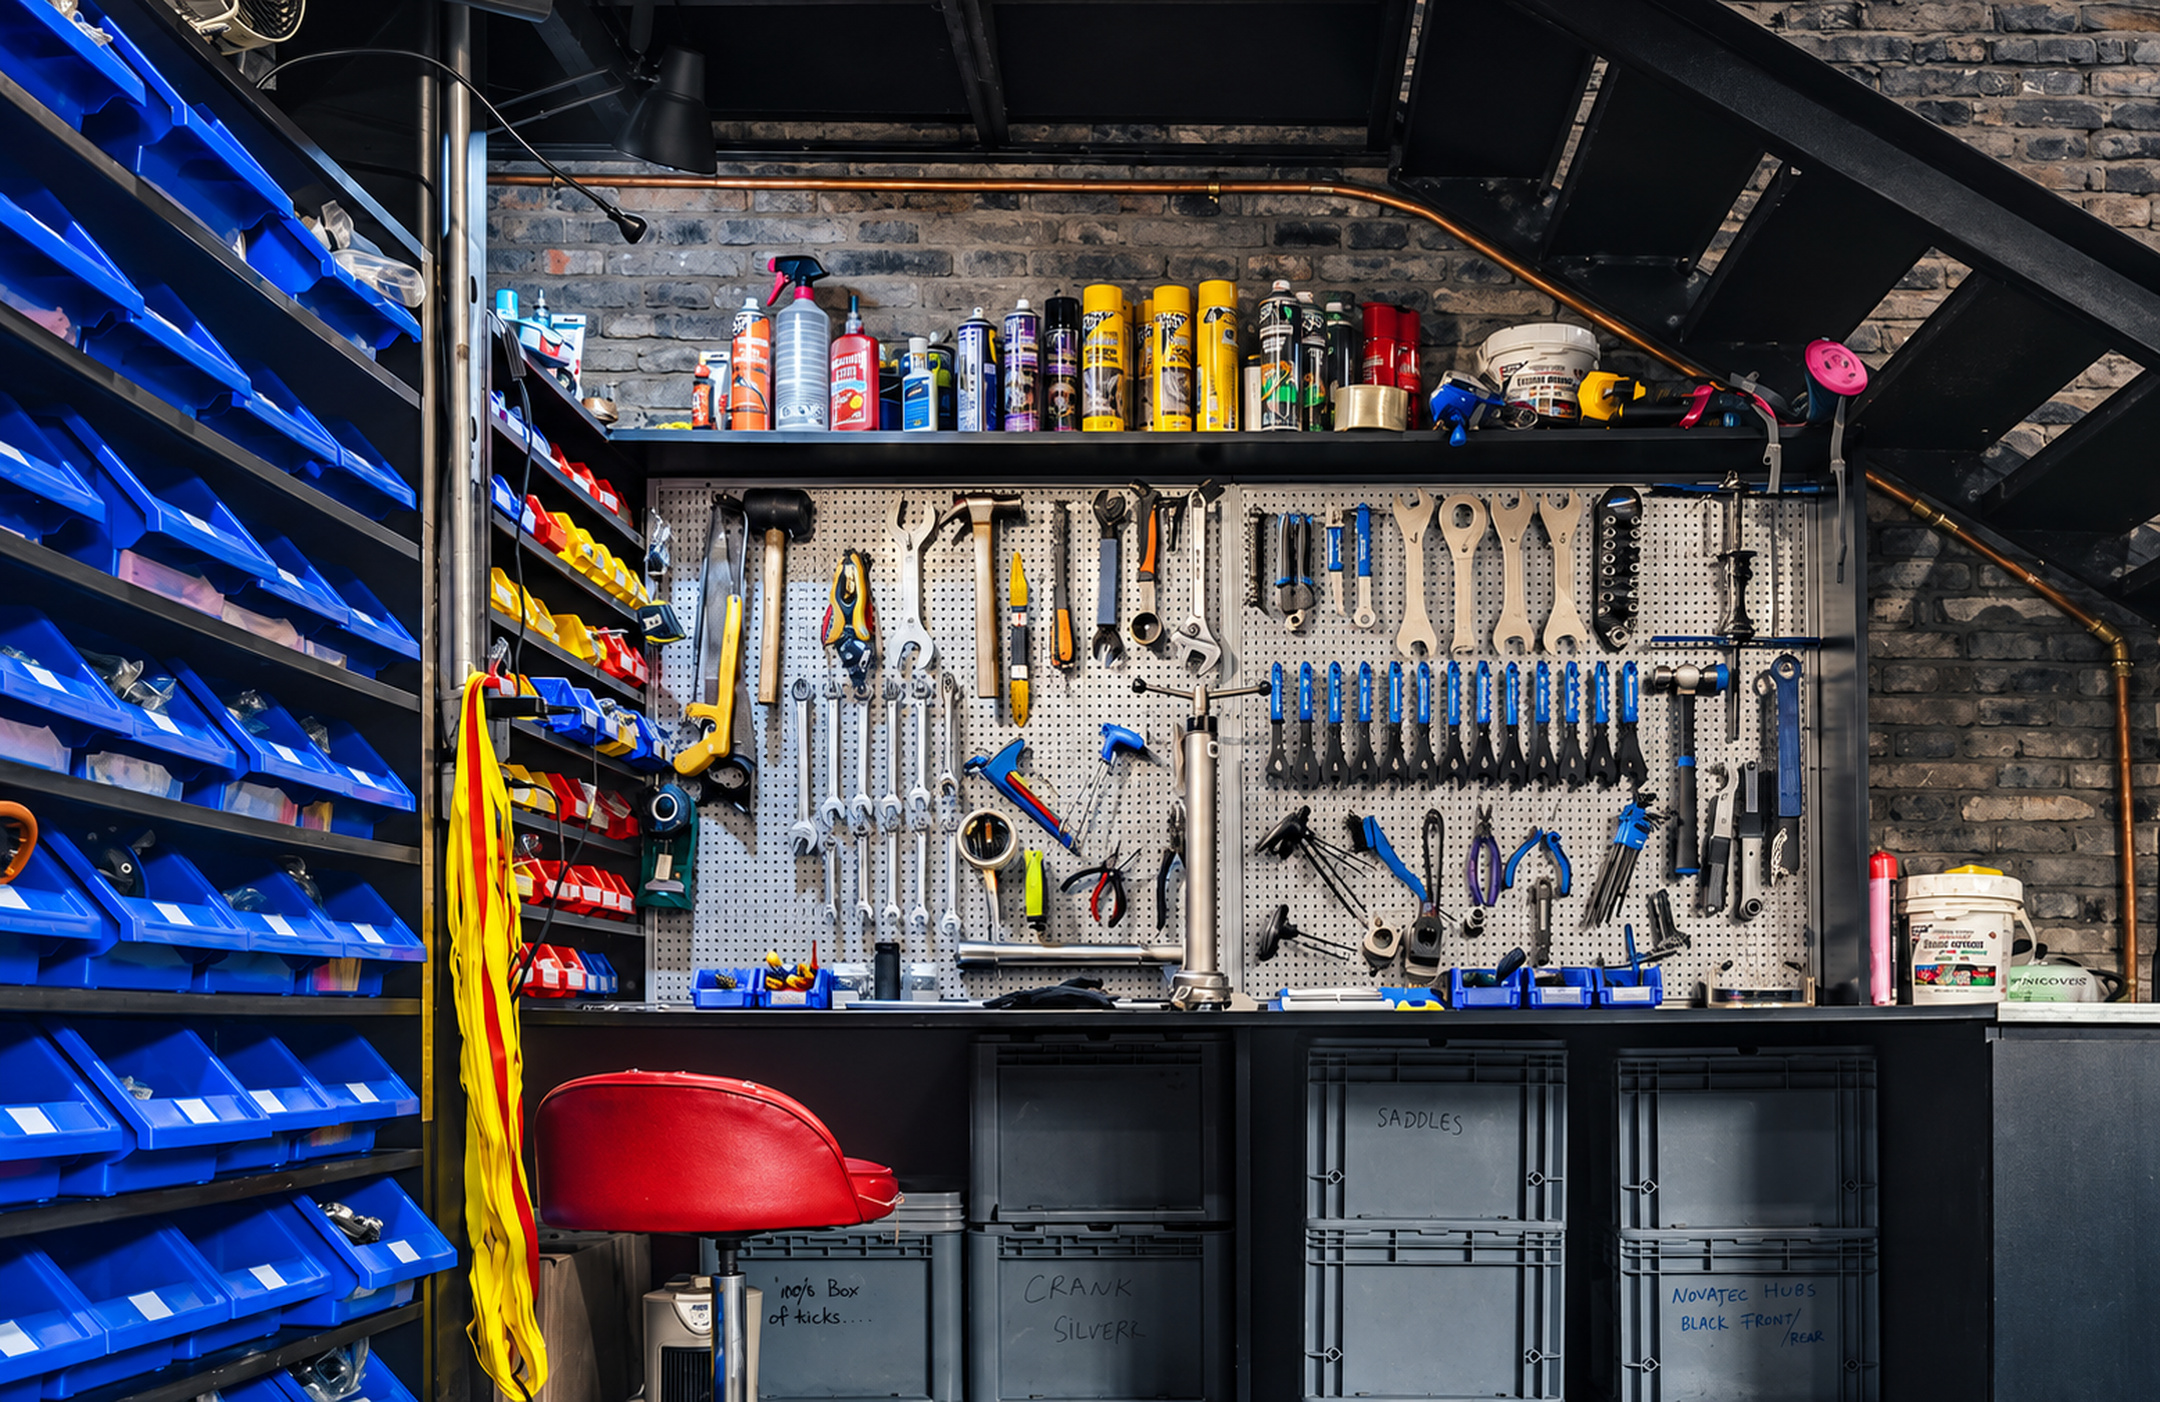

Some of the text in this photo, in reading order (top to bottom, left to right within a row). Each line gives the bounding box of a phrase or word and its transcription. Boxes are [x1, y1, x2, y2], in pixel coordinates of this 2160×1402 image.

[1377, 1107, 1463, 1136] SADDLES
[827, 1278, 860, 1298] Box
[1023, 1274, 1132, 1304] CRANK
[1671, 1282, 1816, 1307] NOVATEC HUBS
[768, 1305, 789, 1328] of
[1681, 1314, 1729, 1332] BLACK
